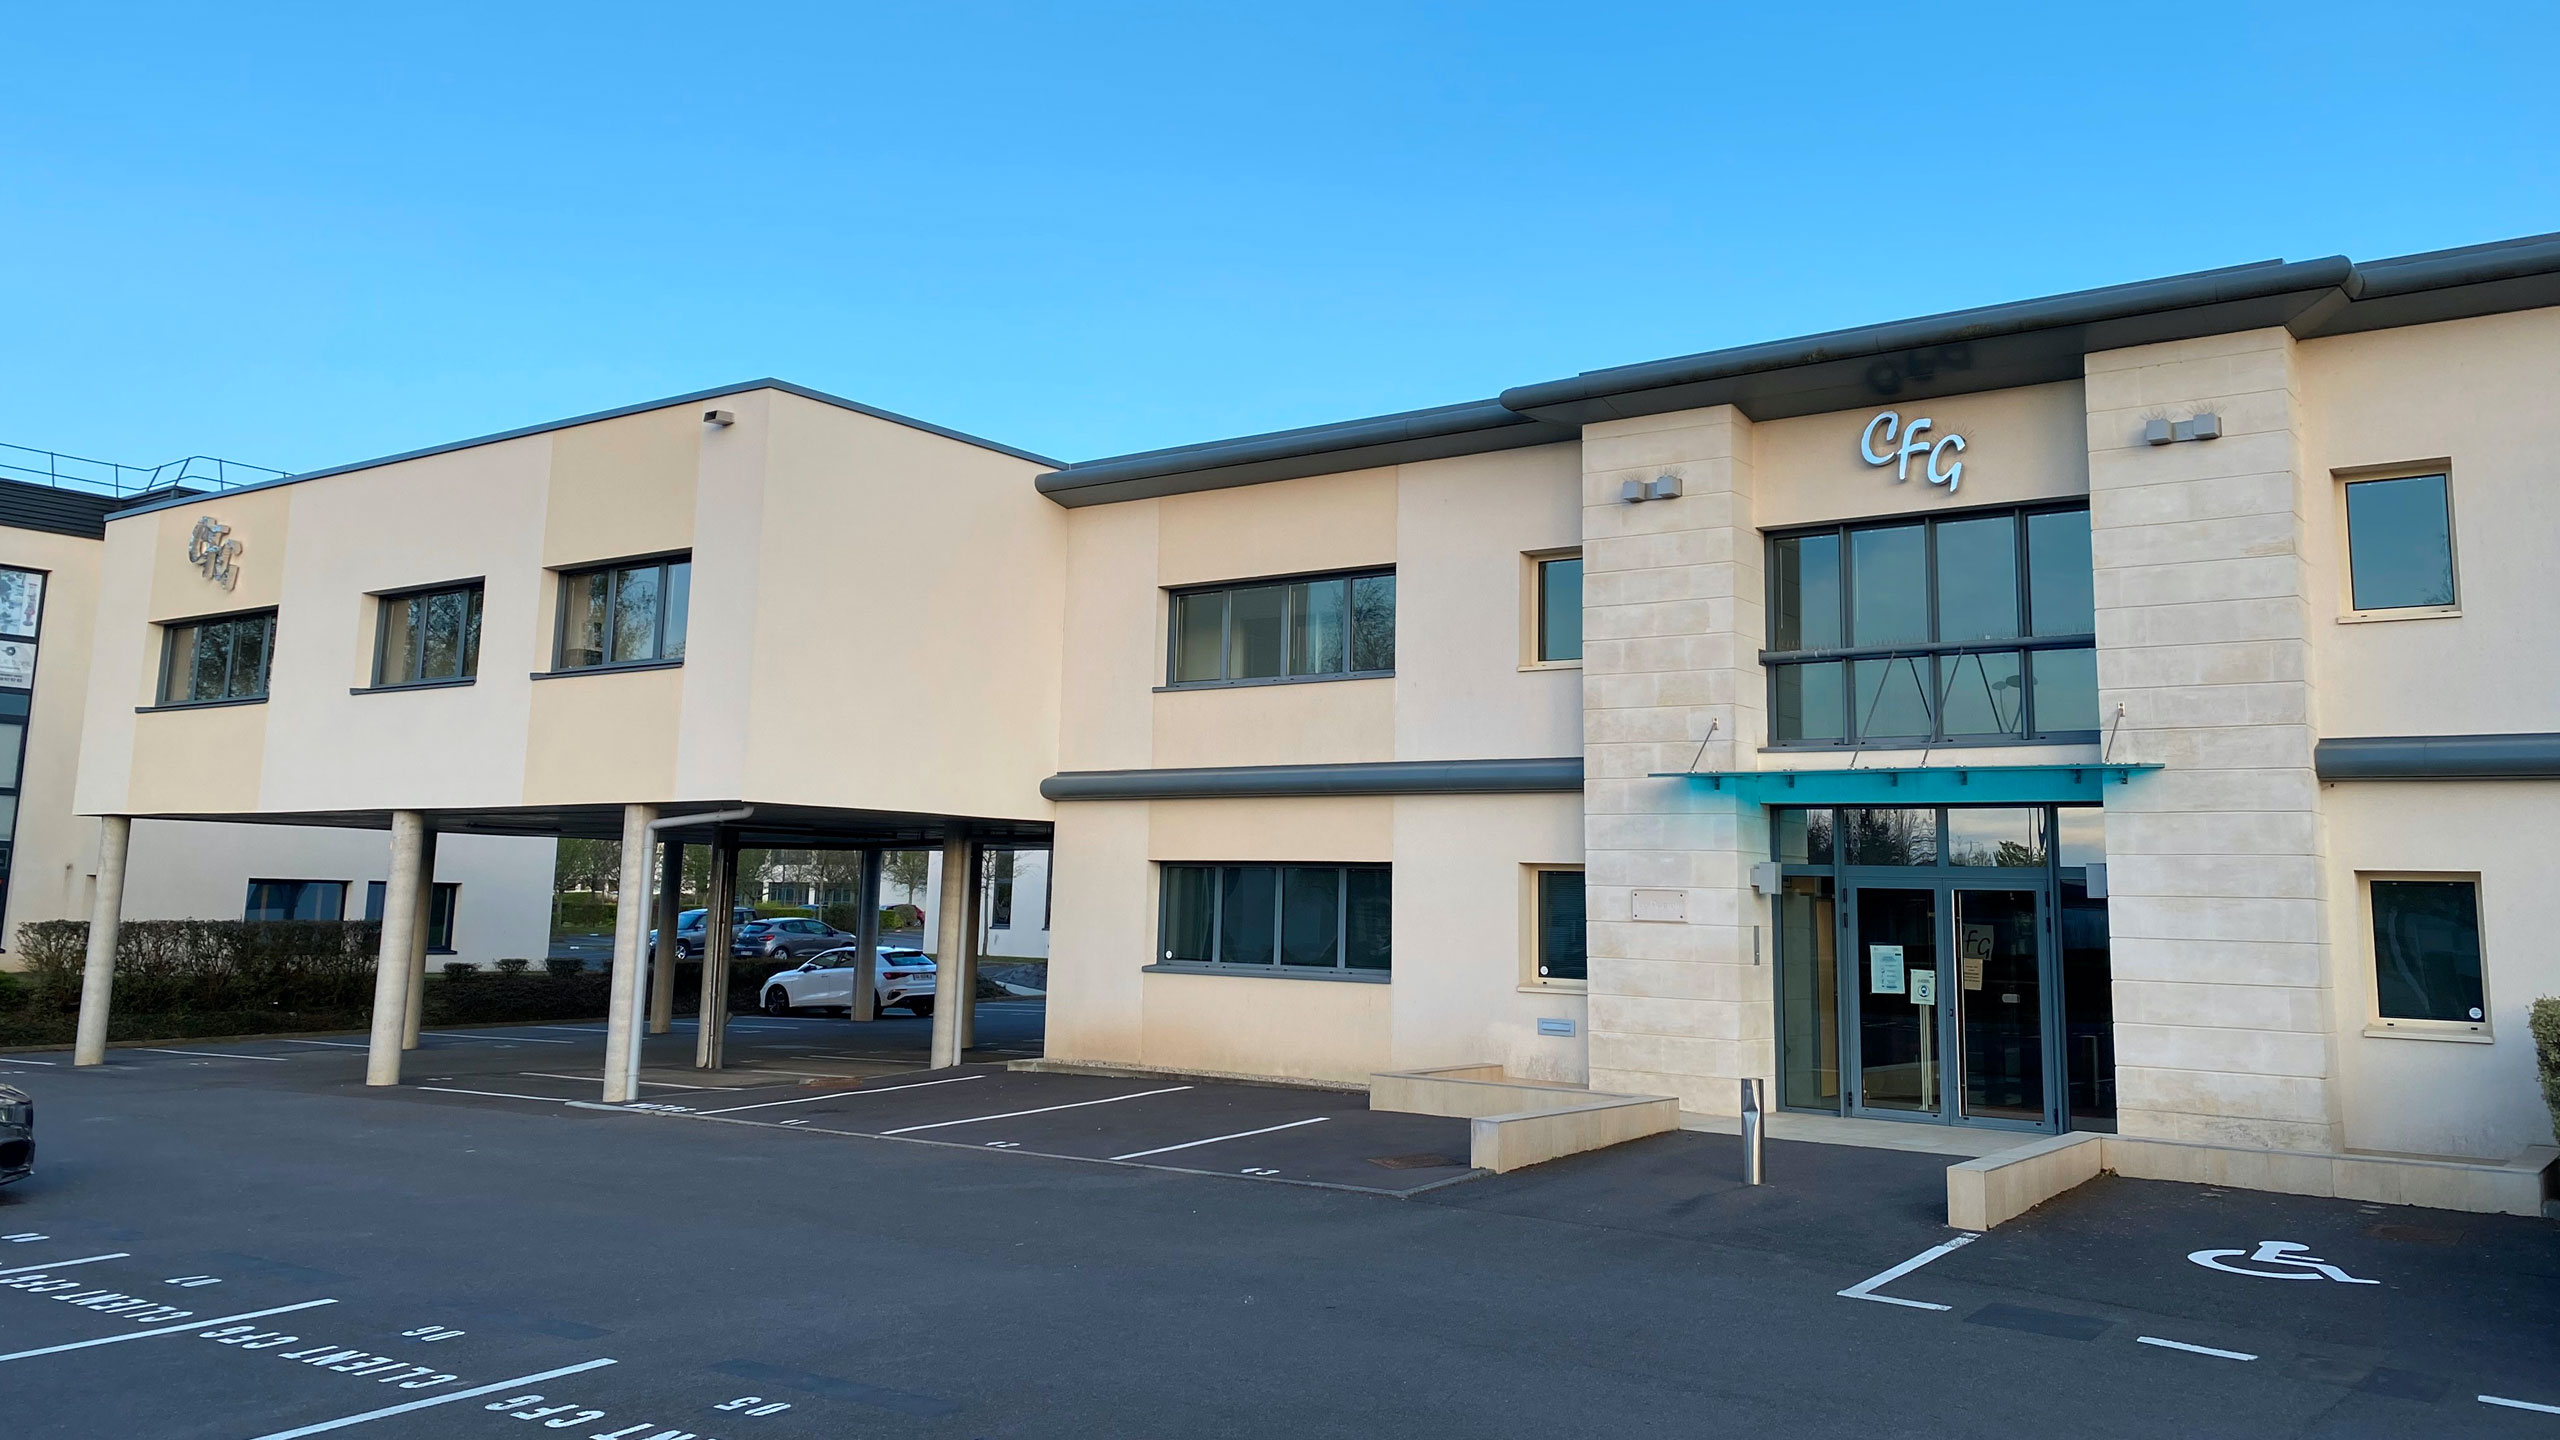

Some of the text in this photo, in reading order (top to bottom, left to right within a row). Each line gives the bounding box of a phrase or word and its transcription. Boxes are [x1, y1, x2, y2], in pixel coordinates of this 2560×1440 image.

[50, 1289, 194, 1323] CLIENT
[198, 1325, 458, 1389] CLIENT CFG
[484, 1394, 606, 1428] CFG
[713, 1396, 792, 1417] 05
